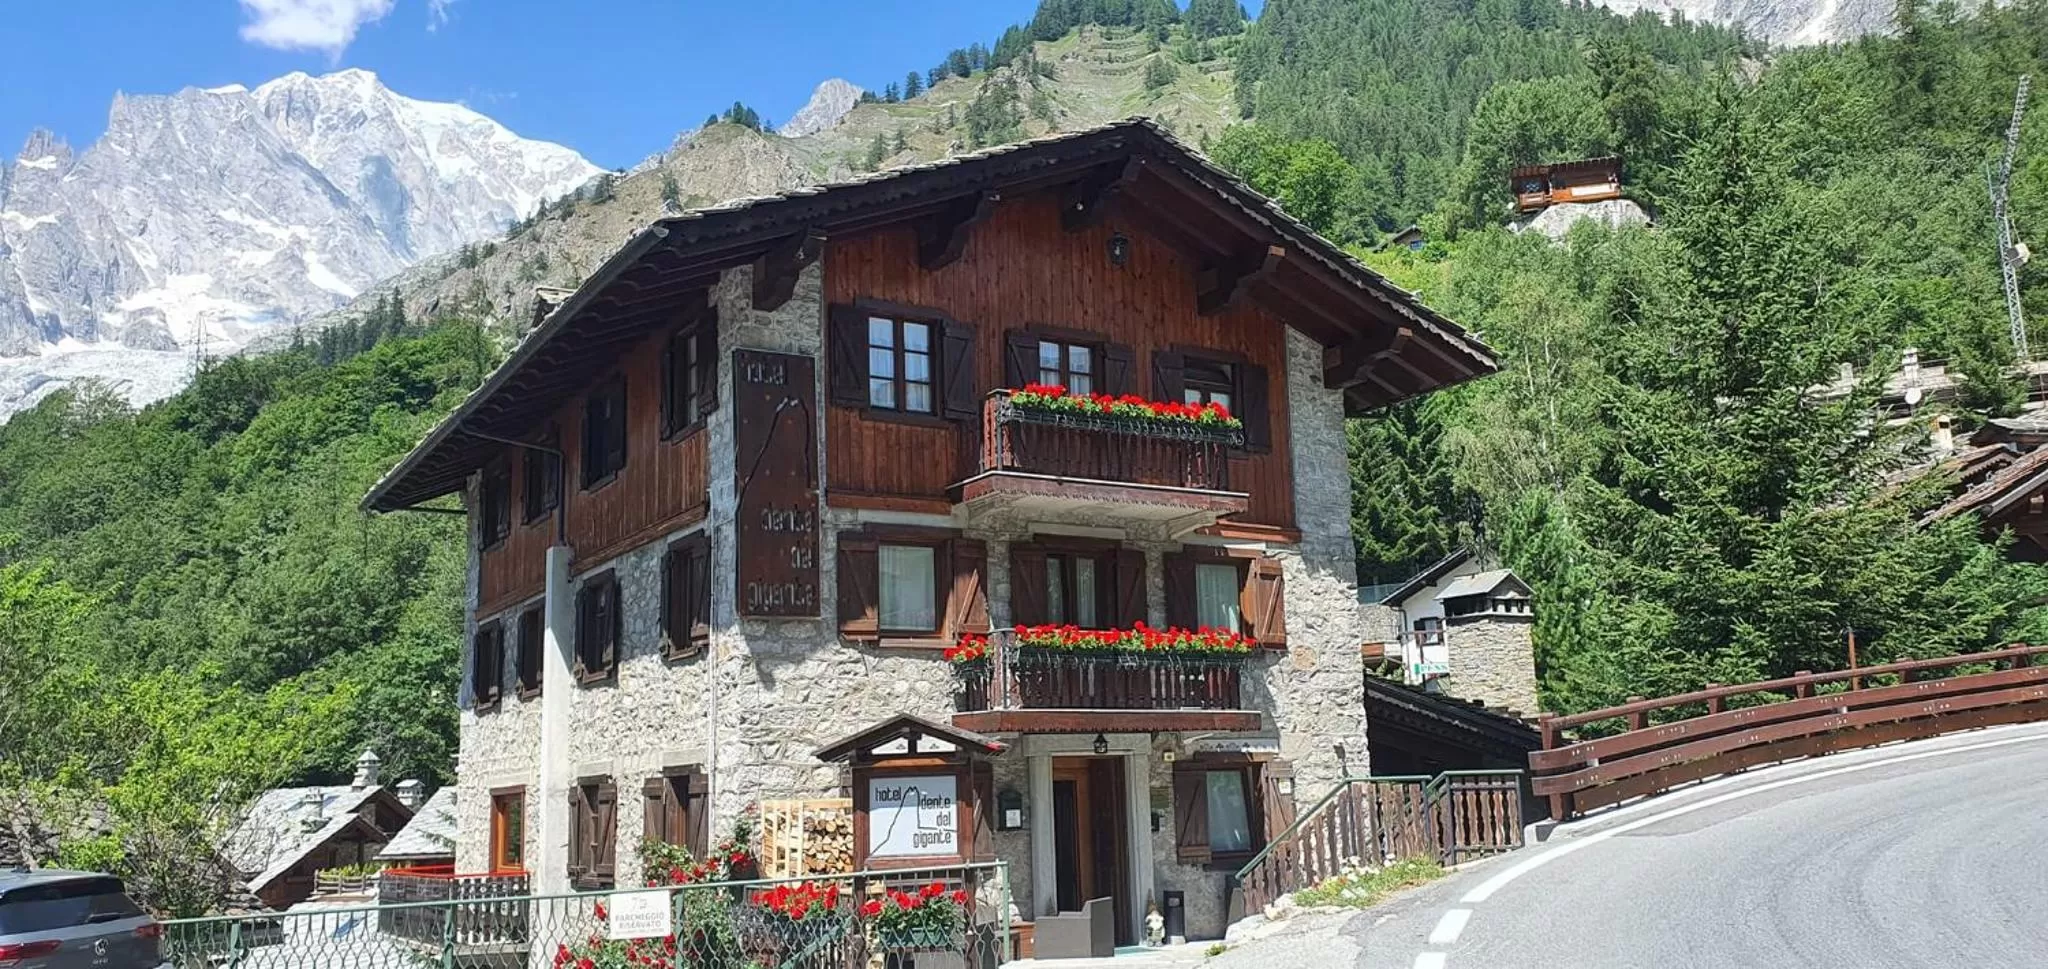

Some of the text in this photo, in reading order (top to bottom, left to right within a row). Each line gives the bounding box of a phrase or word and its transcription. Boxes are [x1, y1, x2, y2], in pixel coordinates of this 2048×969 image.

[875, 787, 901, 802] hotel
[921, 795, 950, 809] dente
[936, 811, 951, 827] del
[913, 829, 951, 848] gigante
